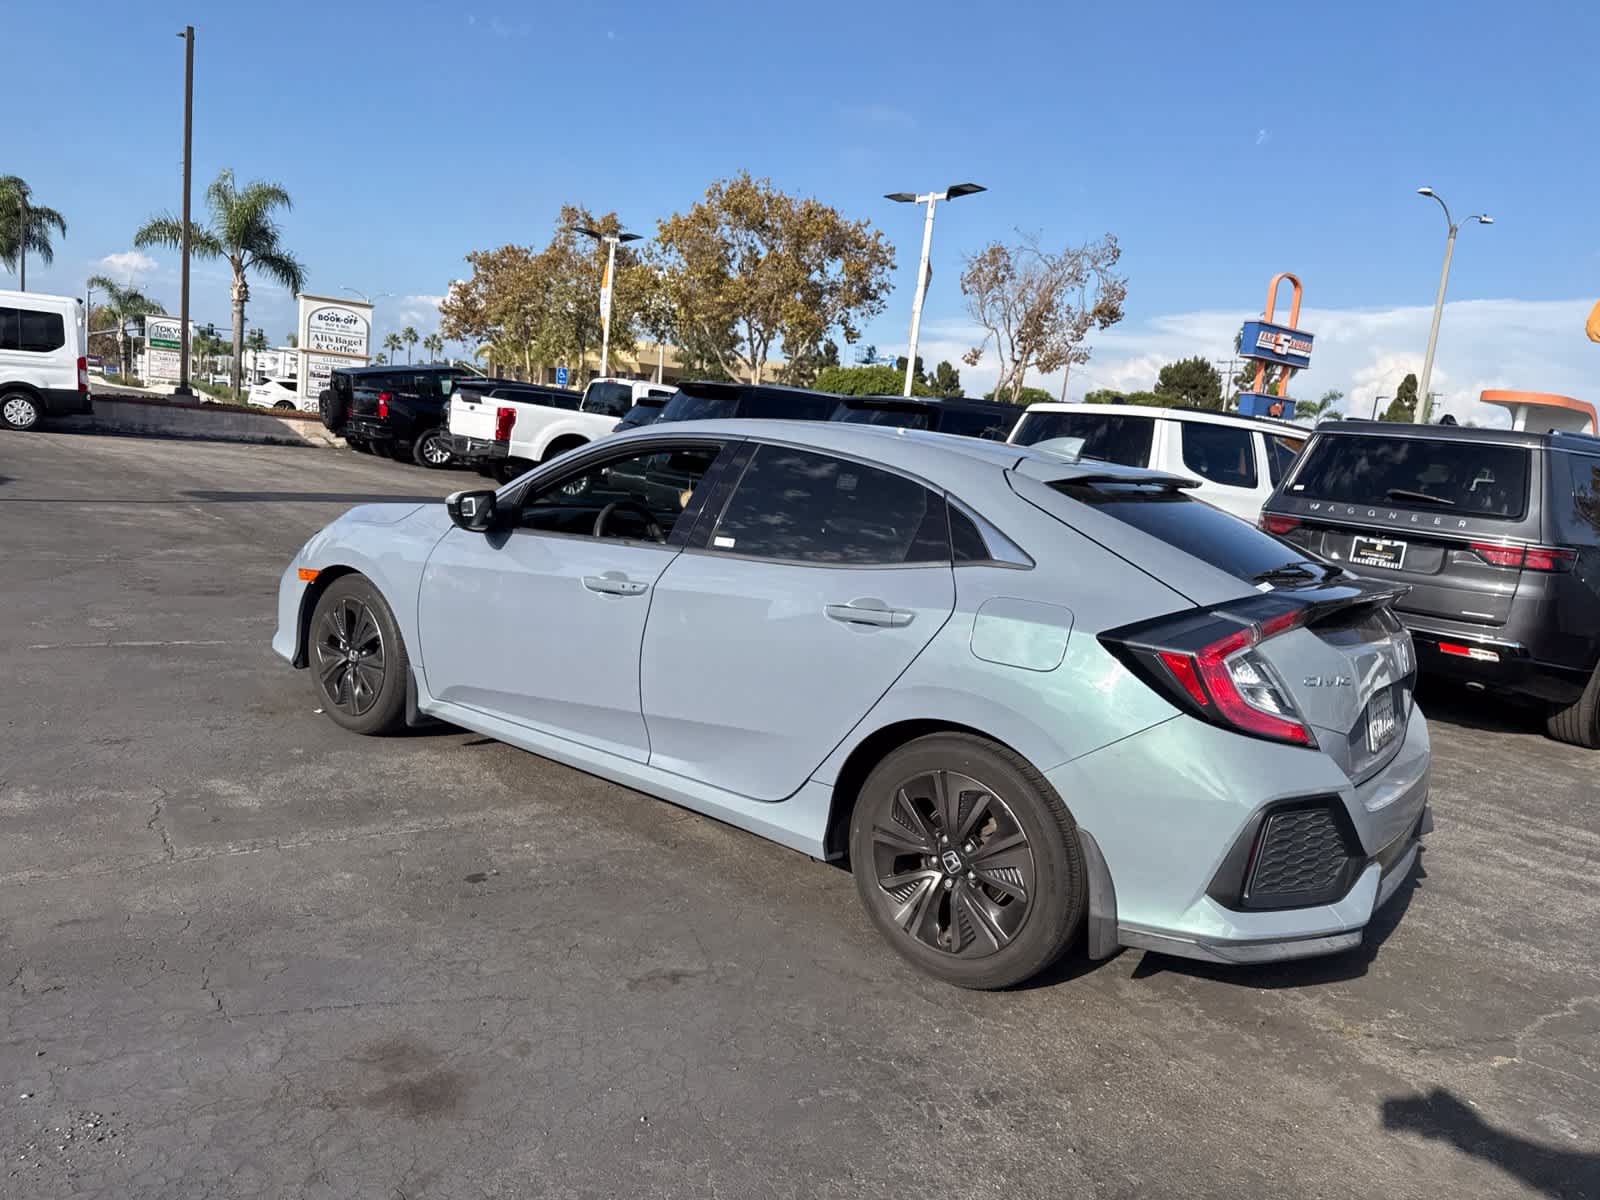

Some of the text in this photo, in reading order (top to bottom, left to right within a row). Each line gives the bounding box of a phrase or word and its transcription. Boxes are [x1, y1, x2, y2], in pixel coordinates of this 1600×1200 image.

[318, 314, 358, 325] BOOK-OFF
[335, 335, 362, 347] Bagel
[326, 343, 358, 353] Coffee
[1309, 503, 1466, 528] WAGONEER
[1303, 675, 1352, 688] CIVIC
